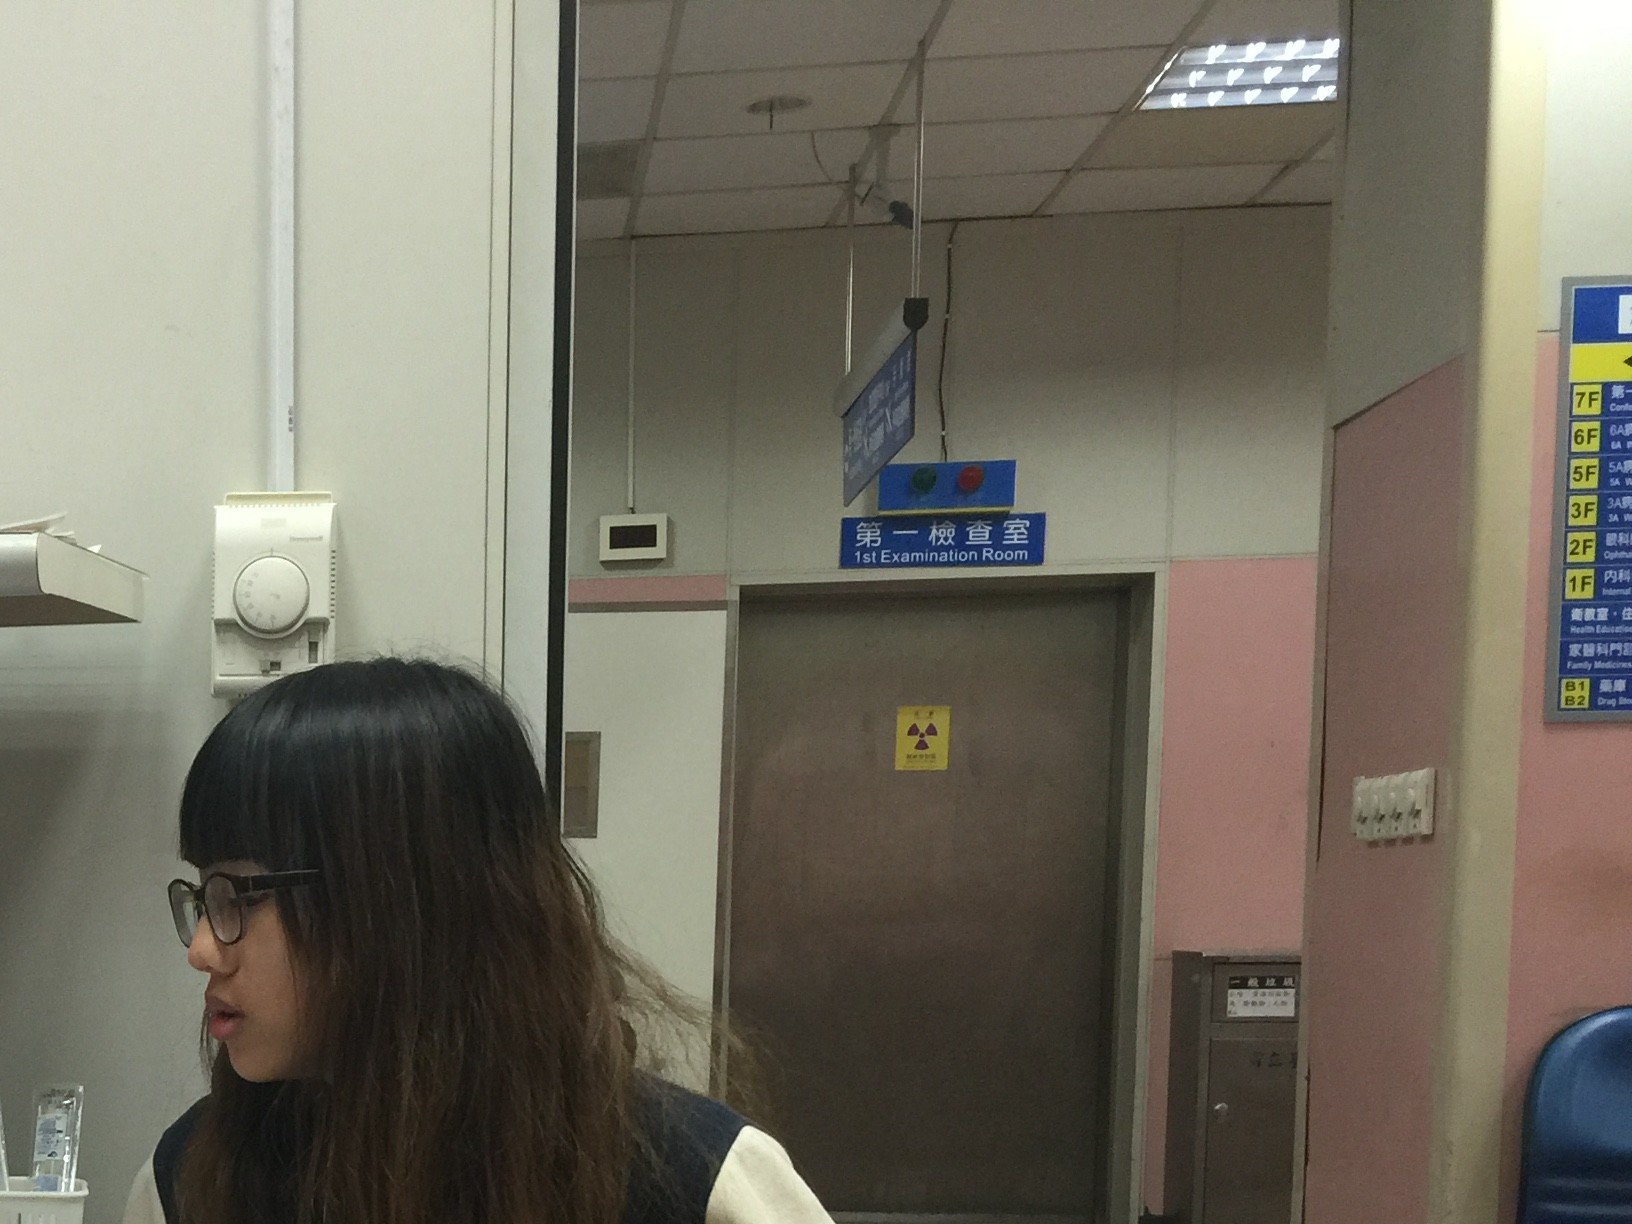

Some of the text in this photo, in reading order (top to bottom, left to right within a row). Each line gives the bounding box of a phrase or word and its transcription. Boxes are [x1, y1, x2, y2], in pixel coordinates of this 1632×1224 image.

[1575, 391, 1600, 409] 7F
[1573, 428, 1599, 446] 6F
[1572, 465, 1597, 482] 5F
[1571, 502, 1595, 519] 3F
[855, 519, 1031, 548] 第一檢查室
[1605, 532, 1632, 546] 眼科
[854, 547, 1029, 564] 1st Examination Room
[1569, 538, 1594, 556] 2F
[1569, 575, 1592, 593] 1F
[1565, 681, 1585, 692] B1
[1564, 695, 1586, 706] B2
